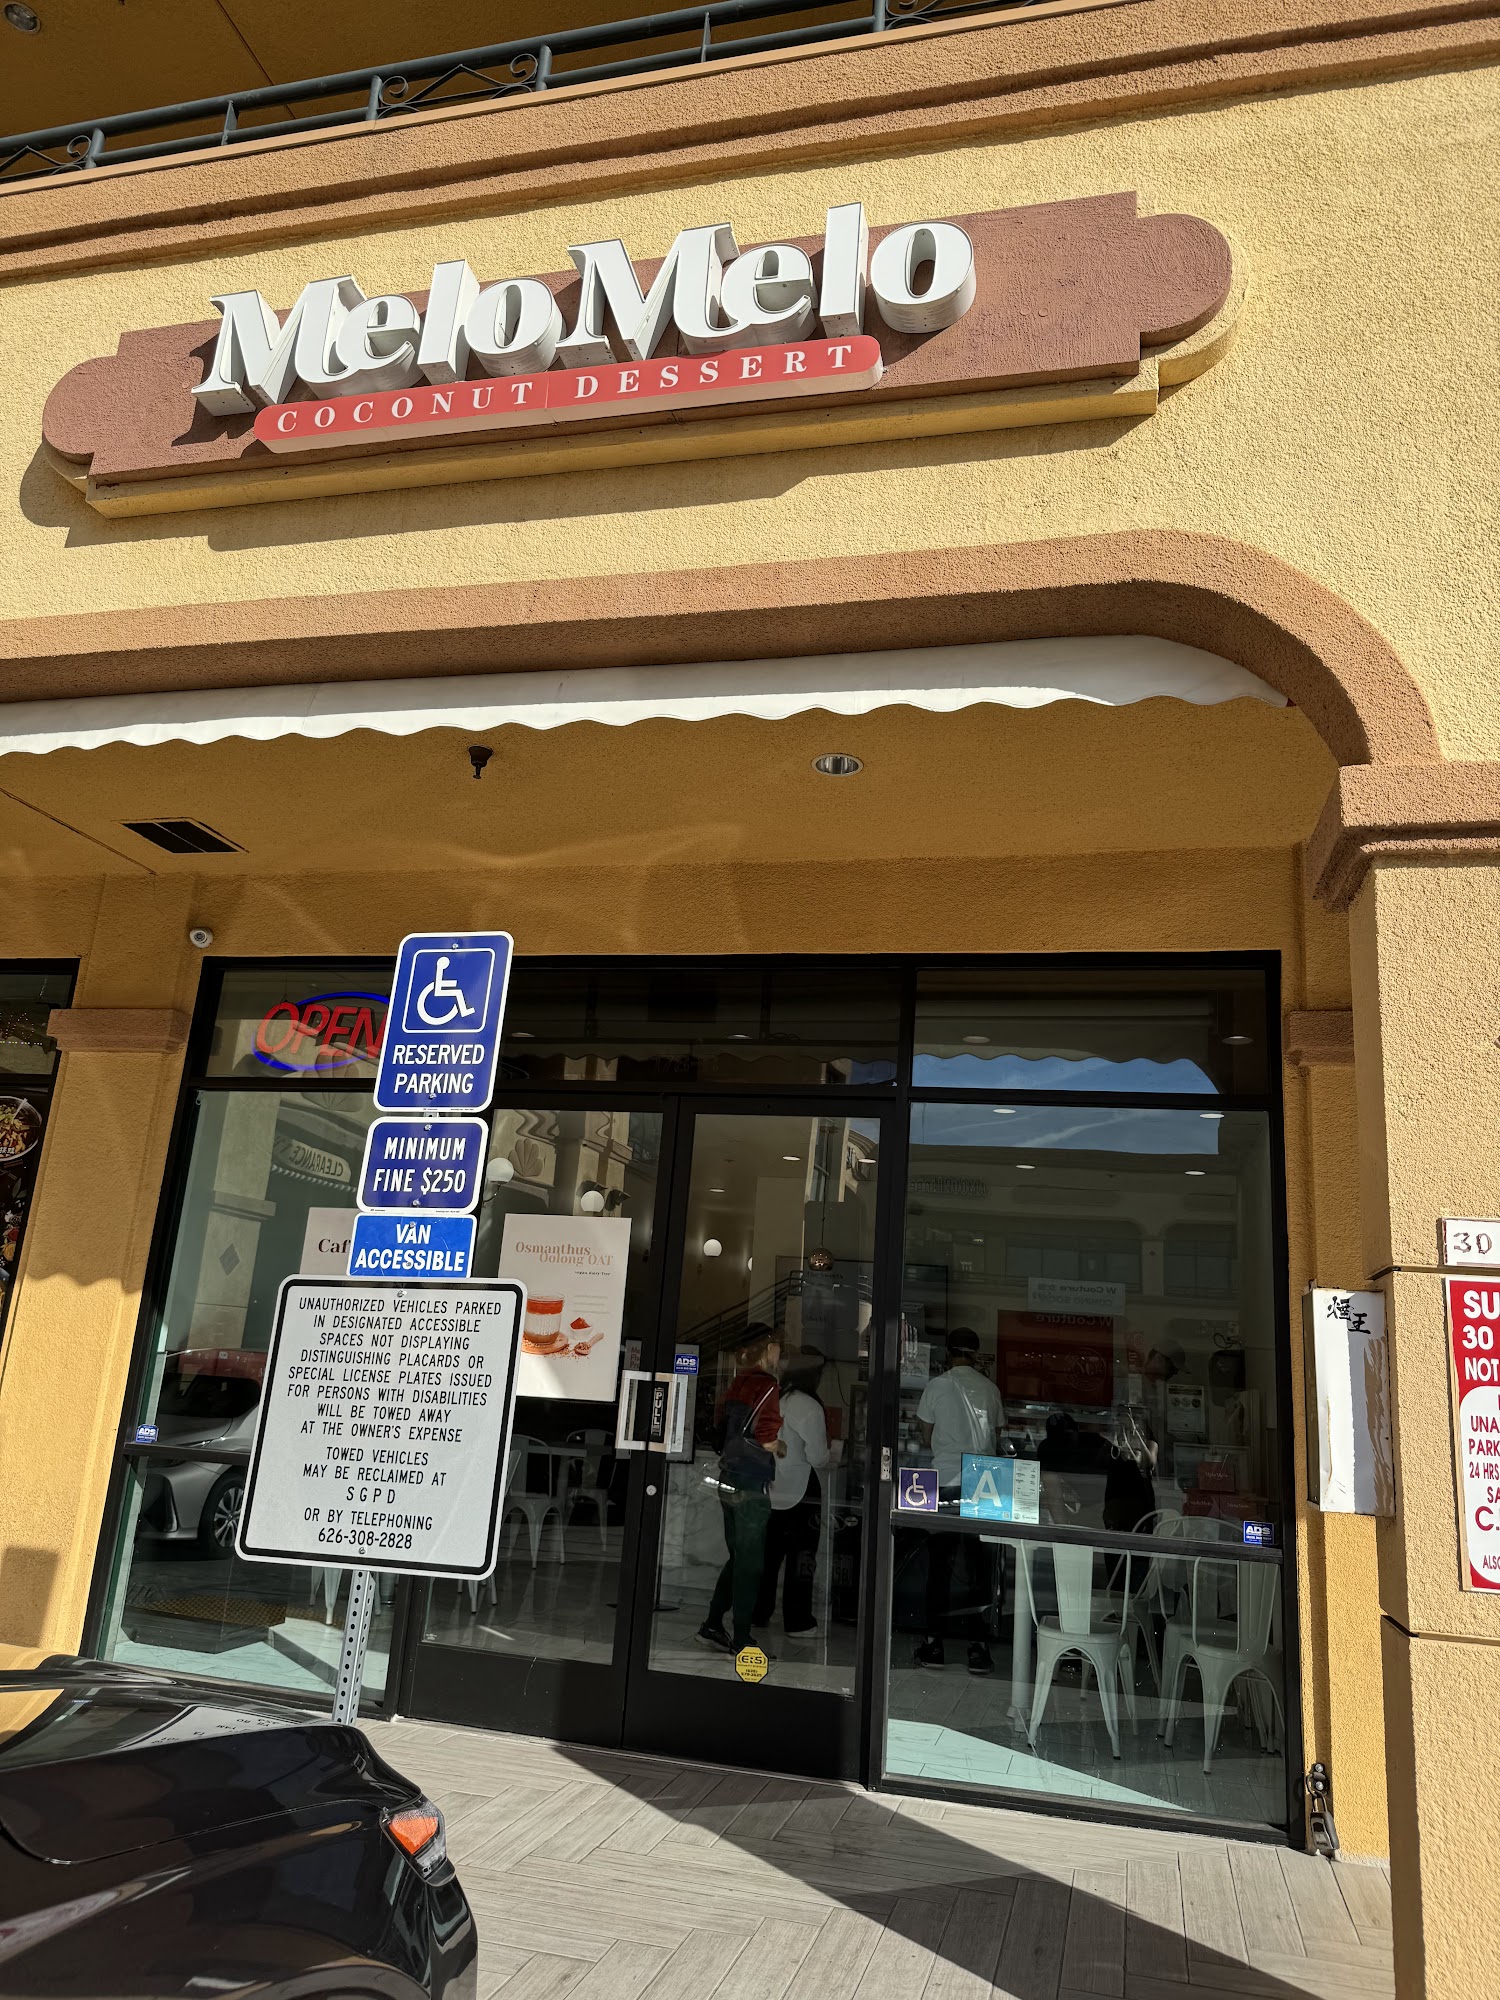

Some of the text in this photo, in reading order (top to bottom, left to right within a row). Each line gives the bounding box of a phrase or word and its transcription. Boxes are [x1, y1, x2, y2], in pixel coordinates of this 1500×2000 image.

[276, 344, 852, 434] COCONUT DESSERT
[391, 1044, 485, 1065] RESERVED
[393, 1072, 475, 1094] PARKING
[383, 1136, 466, 1161] MINIMUM
[372, 1167, 466, 1195] FINE $250
[396, 1223, 432, 1244] VAN
[1452, 1231, 1493, 1255] 30
[515, 1241, 591, 1255] Osmanthus
[355, 1248, 465, 1271] ACCESSIBLE
[539, 1253, 614, 1267] Oolong OAT
[299, 1297, 501, 1315] UNAUTHORIZED VEHICLES PARKED
[313, 1314, 481, 1333] IN DESIGNATED ACCESSIBLE
[319, 1332, 470, 1350] SPACES NOT DISPLAYING
[1461, 1324, 1494, 1350] 30
[300, 1349, 484, 1369] DISTINGUISHING PLACARDS OR
[676, 1358, 696, 1366] ADS
[1464, 1357, 1500, 1382] NOT
[288, 1366, 492, 1388] SPECIAL LICENSE PLATES ISSUED
[287, 1383, 488, 1406] FOR PERSONS WITH DISABILITIES
[317, 1402, 451, 1423] WILL BE TOWED AWAY
[653, 1392, 663, 1425] PULL
[138, 1427, 156, 1436] ADS
[300, 1420, 463, 1443] AT THE OWNER'S EXPENSE
[326, 1446, 429, 1466] TOWED VEHICLES
[302, 1463, 447, 1486] MAY BE RECLAIMED AT
[1469, 1461, 1499, 1481] 24 HRS
[971, 1470, 1003, 1508] A
[304, 1507, 433, 1531] OR BY TELEPHONING
[1246, 1525, 1271, 1535] ADS
[318, 1527, 413, 1550] 626-308-2828
